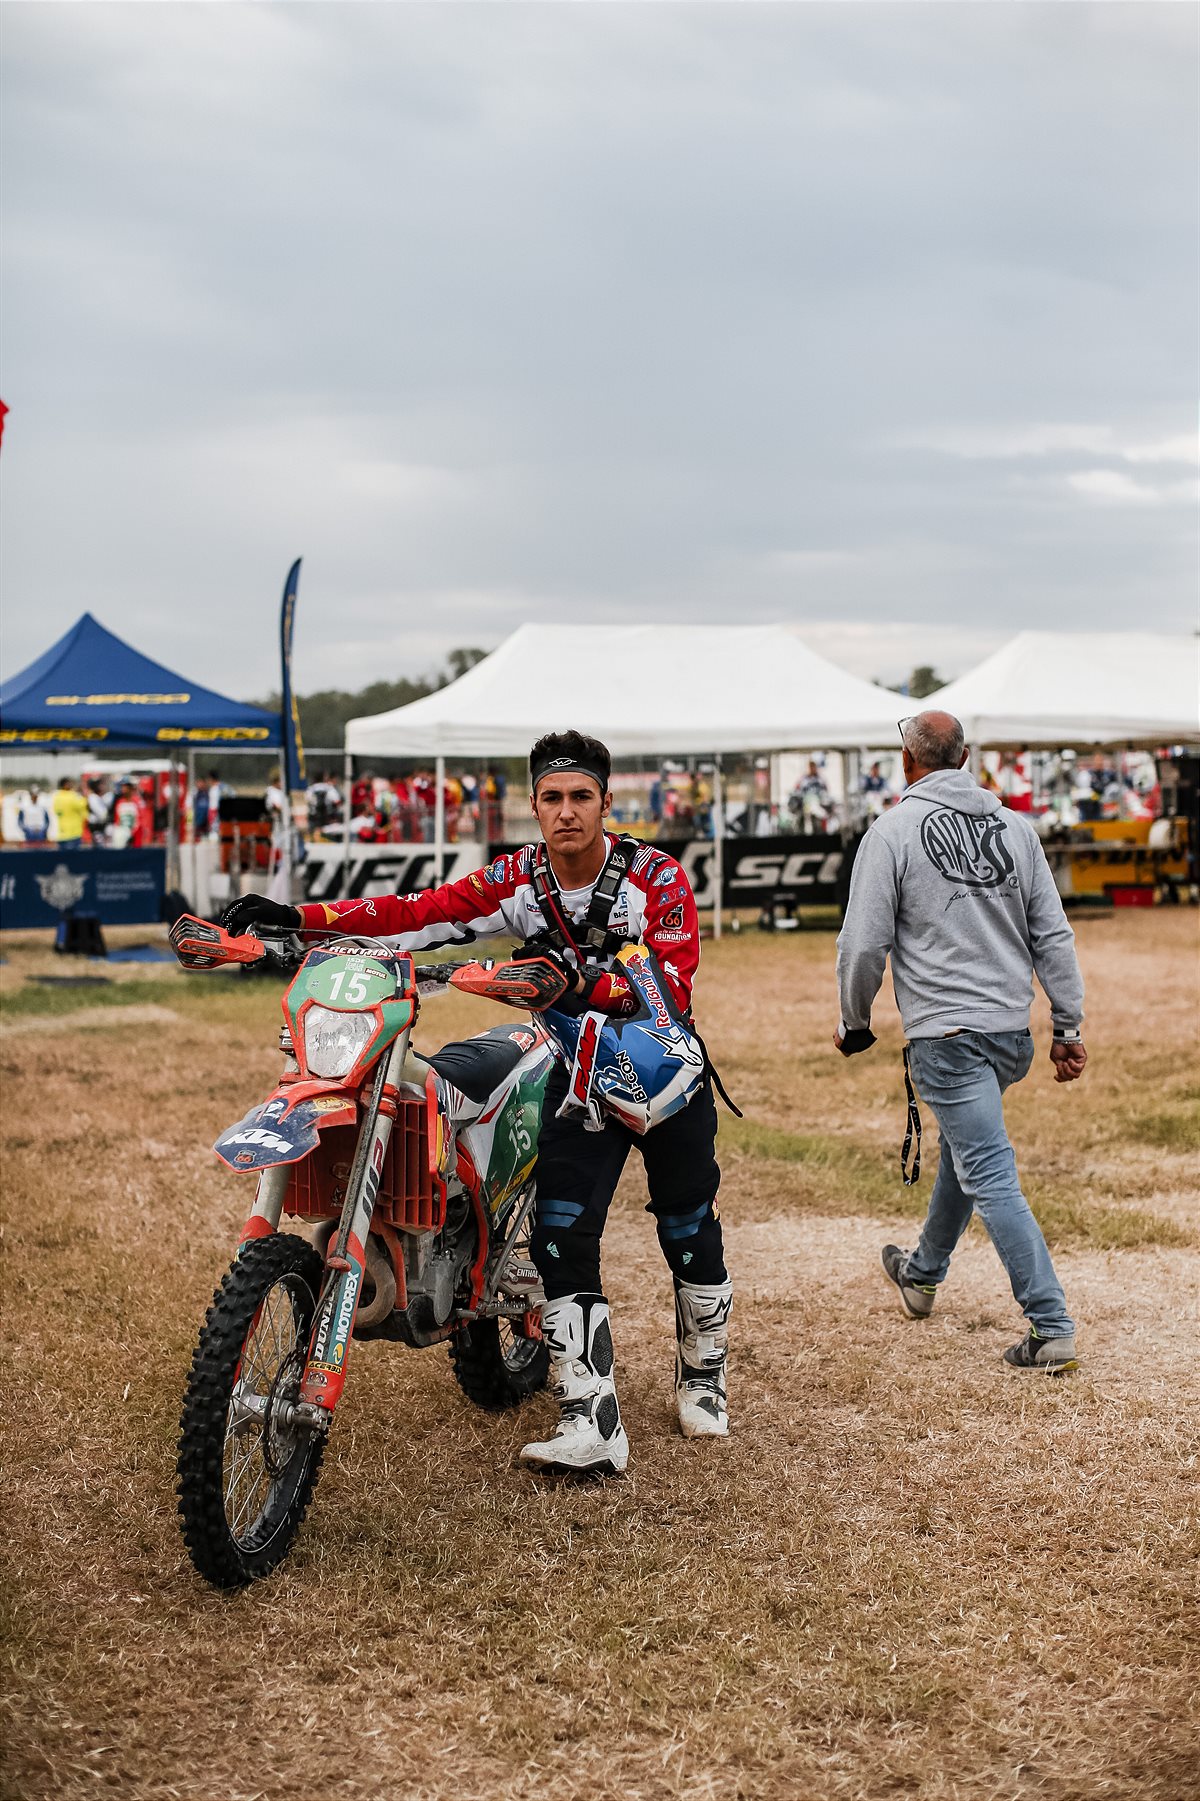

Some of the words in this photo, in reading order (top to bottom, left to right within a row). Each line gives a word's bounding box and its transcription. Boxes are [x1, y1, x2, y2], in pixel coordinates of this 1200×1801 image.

[664, 910, 681, 926] 66
[329, 971, 372, 1004] 15
[365, 967, 387, 980] MOTUL
[573, 1016, 598, 1105] FMF
[221, 1128, 294, 1154] KTM
[508, 1118, 532, 1160] 15
[335, 1270, 360, 1343] MOTOREX
